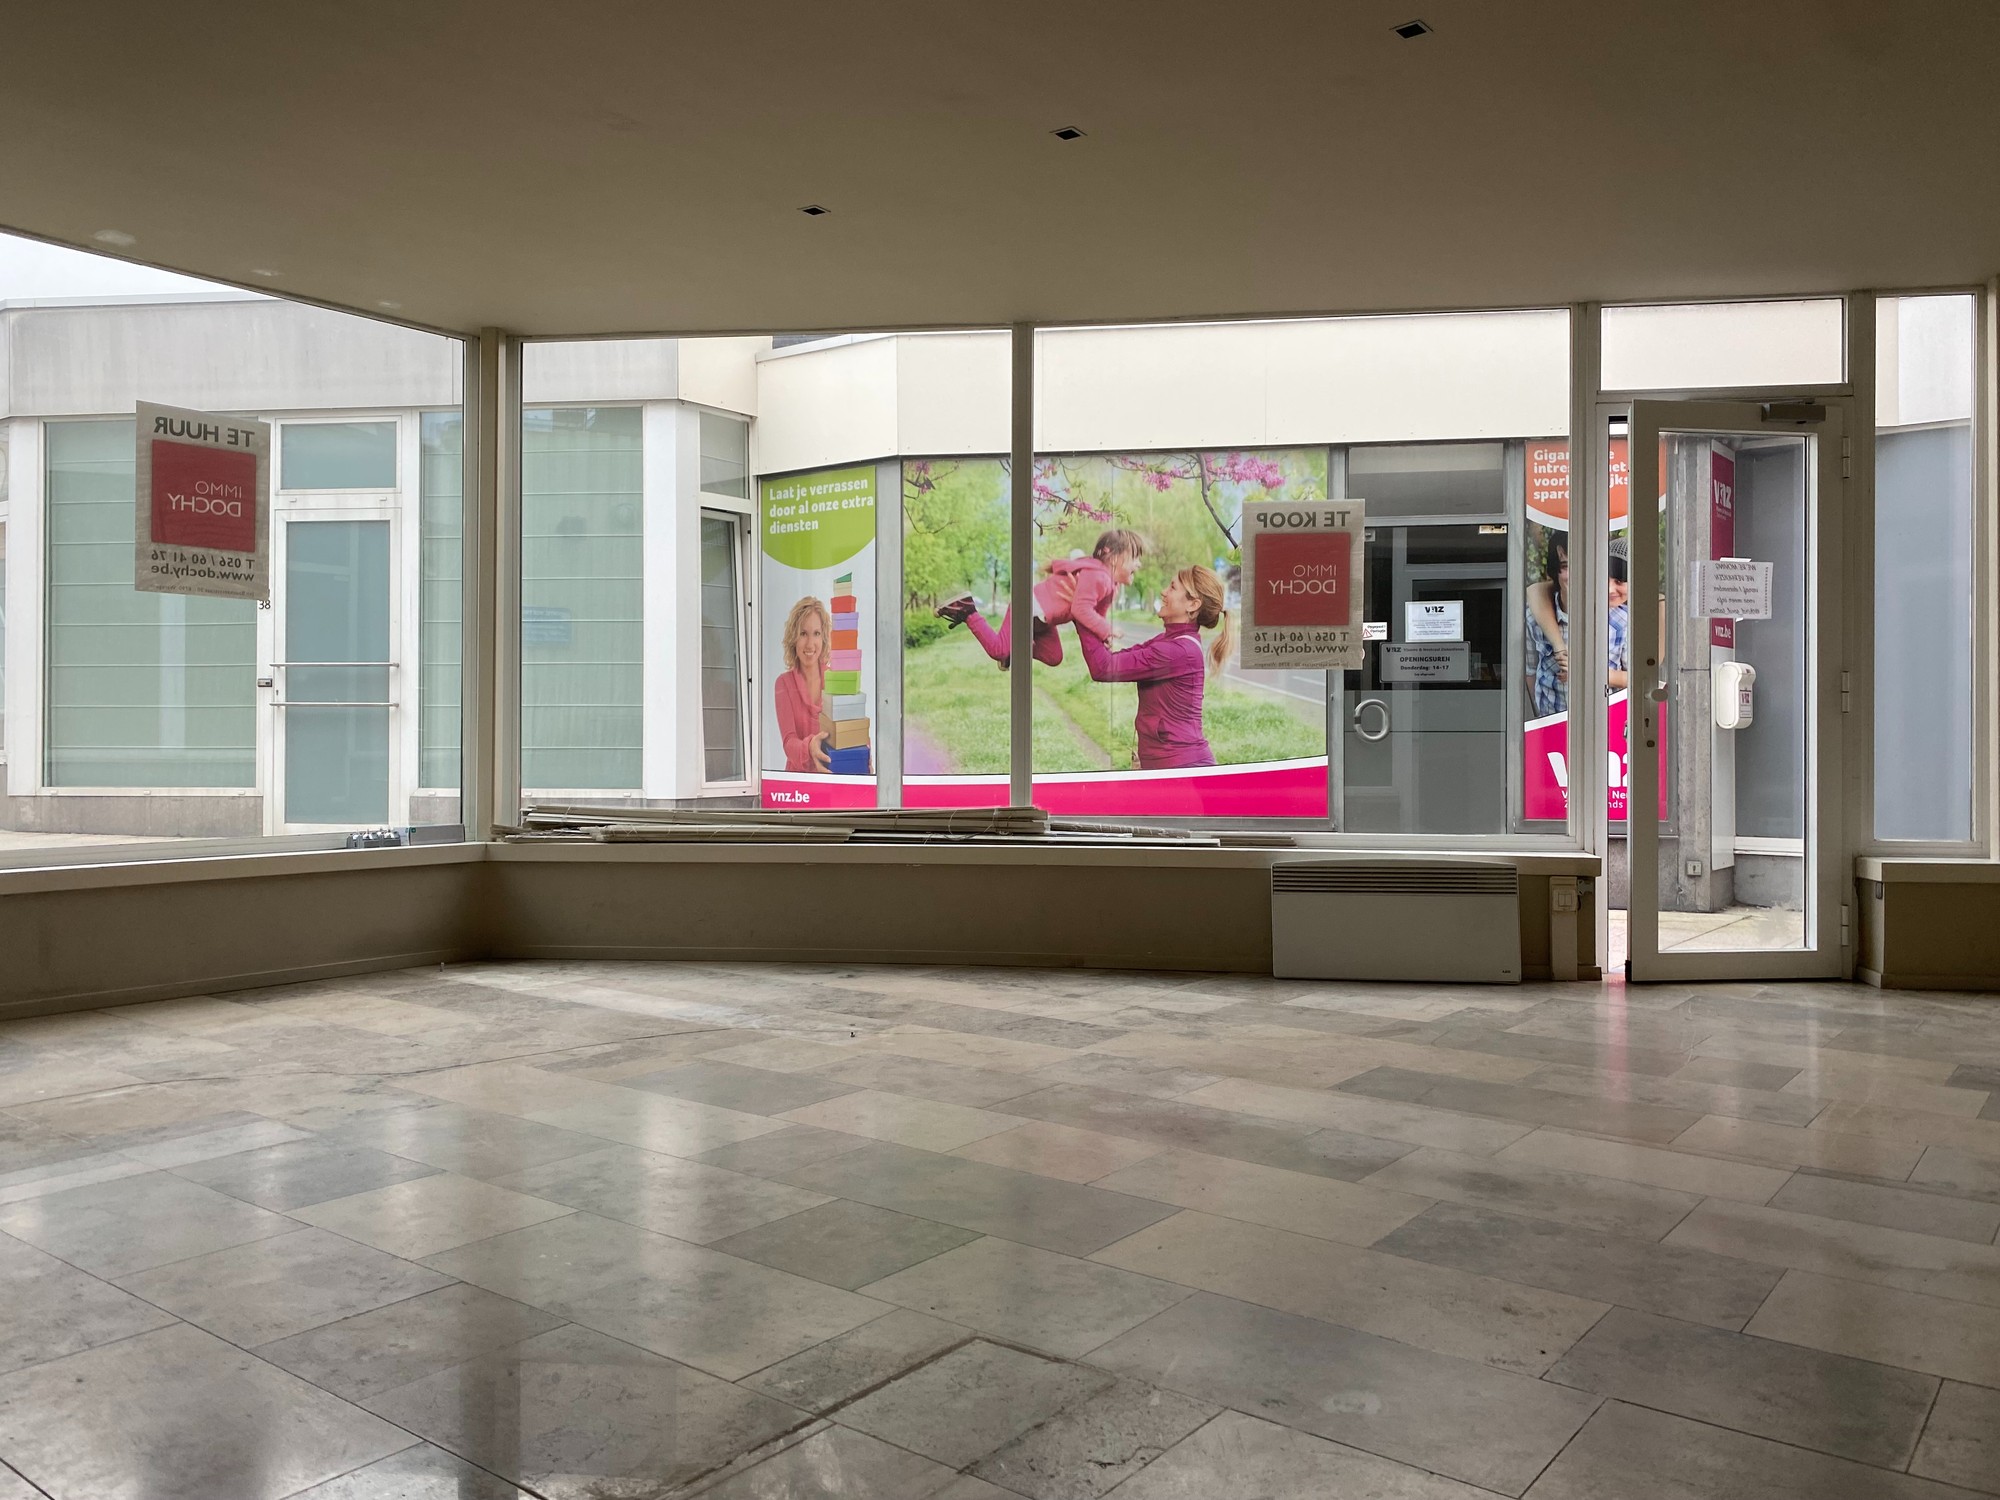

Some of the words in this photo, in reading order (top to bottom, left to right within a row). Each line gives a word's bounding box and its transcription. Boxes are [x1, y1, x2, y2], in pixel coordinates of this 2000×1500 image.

[770, 486, 794, 500] Laat
[796, 484, 807, 501] je
[809, 479, 868, 496] verrassen
[770, 504, 796, 517] door
[798, 500, 809, 514] al
[811, 500, 839, 513] onze
[841, 495, 874, 509] extra
[770, 519, 819, 534] diensten
[259, 600, 271, 610] 38
[771, 790, 810, 803] vnz.be
